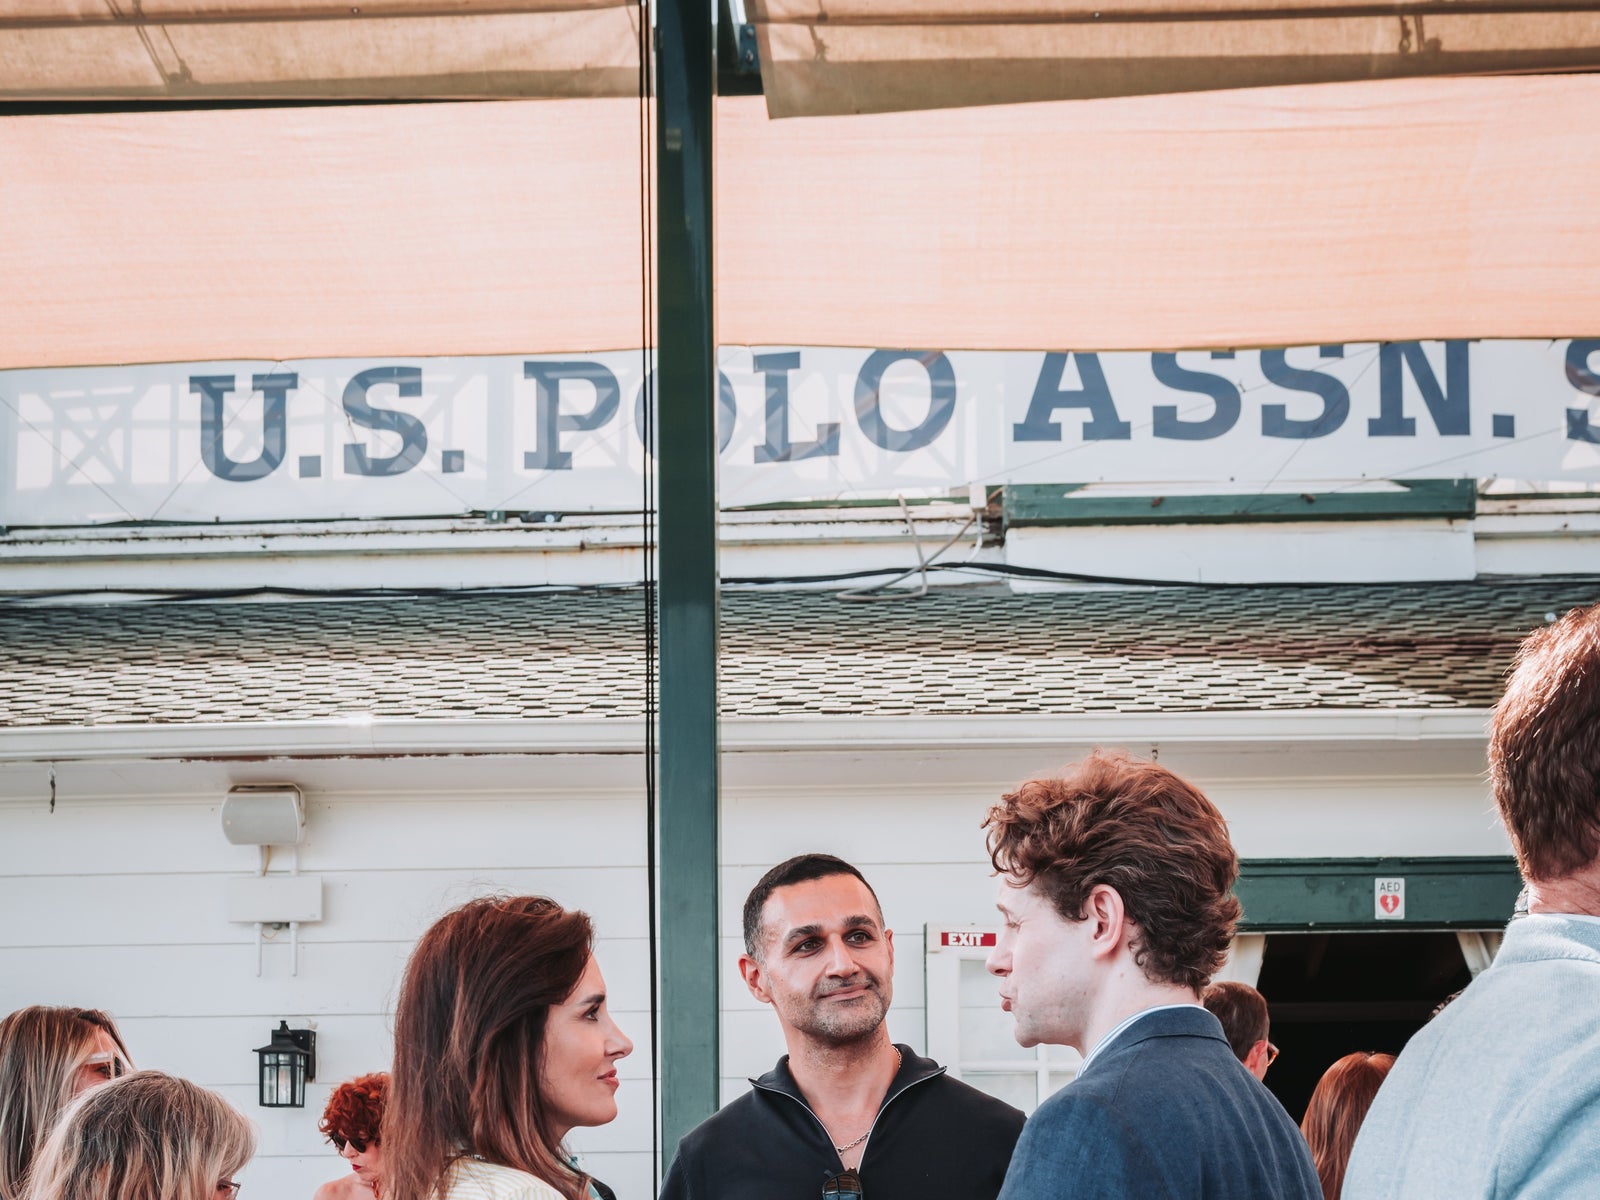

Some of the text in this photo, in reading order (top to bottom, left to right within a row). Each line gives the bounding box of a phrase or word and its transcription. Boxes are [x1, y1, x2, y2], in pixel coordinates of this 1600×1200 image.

[189, 365, 465, 482] U.S.
[1012, 339, 1515, 442] ASSN.
[1380, 881, 1401, 892] AED
[948, 932, 984, 946] EXIT
